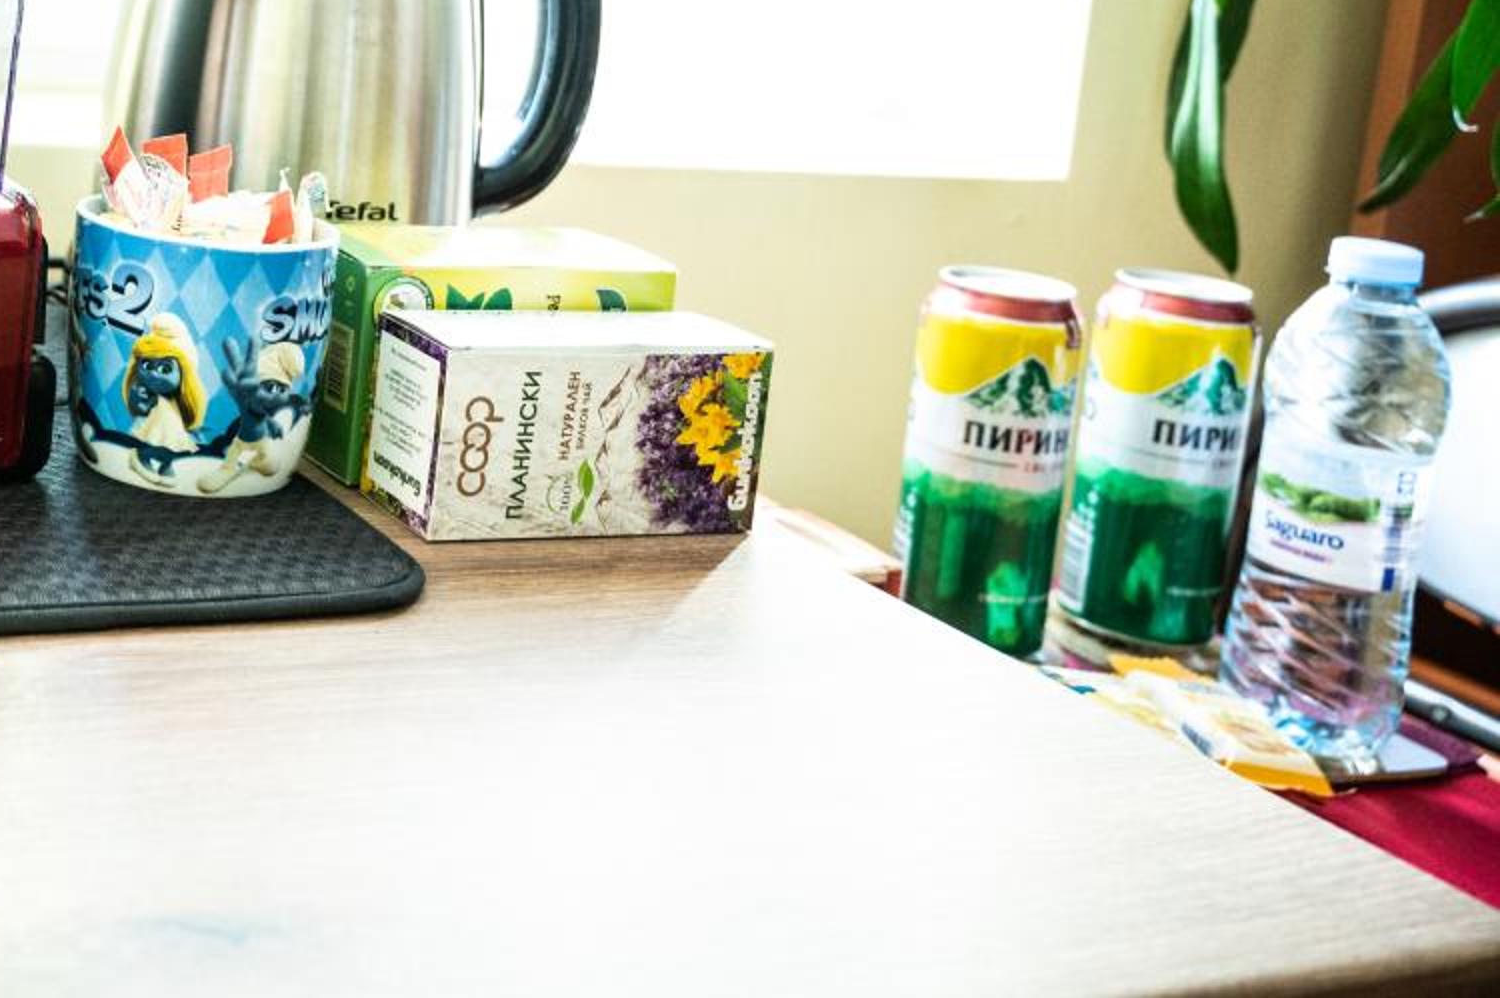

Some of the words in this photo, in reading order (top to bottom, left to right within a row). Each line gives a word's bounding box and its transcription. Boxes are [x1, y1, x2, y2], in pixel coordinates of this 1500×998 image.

[106, 263, 155, 337] 2
[504, 370, 543, 520] ПЛАНИНСКИ
[557, 370, 581, 461] НАТУРАЛЕН
[1266, 510, 1345, 550] Saguaro
